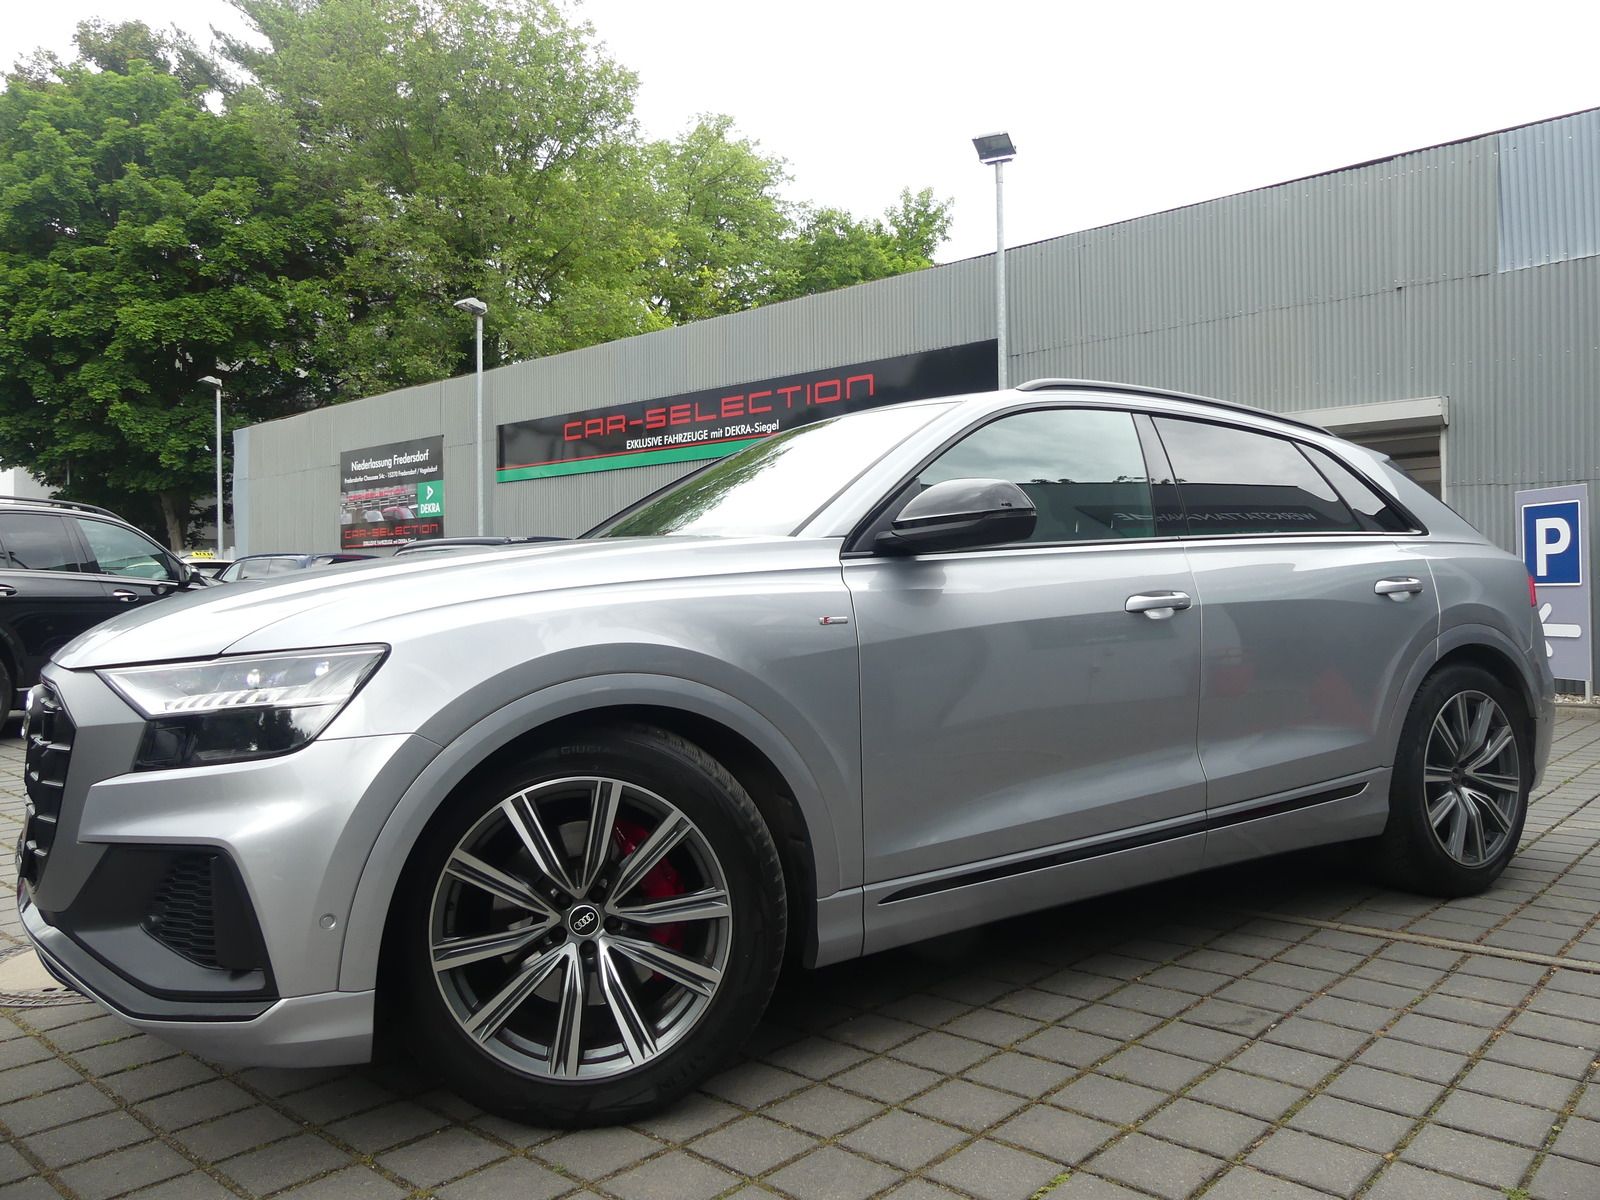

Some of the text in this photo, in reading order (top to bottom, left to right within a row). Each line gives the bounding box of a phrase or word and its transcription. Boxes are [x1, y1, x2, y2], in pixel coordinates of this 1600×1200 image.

[563, 374, 874, 442] CAR-SELECTION
[626, 419, 780, 450] EXKLUSIVE FAHRZEUGE mit DEKRA-Siegel
[351, 449, 429, 472] Niederlassung Fredersdorf
[420, 503, 440, 513] DEKRA
[344, 524, 438, 539] CAR-SELECTION
[1535, 517, 1571, 577] P
